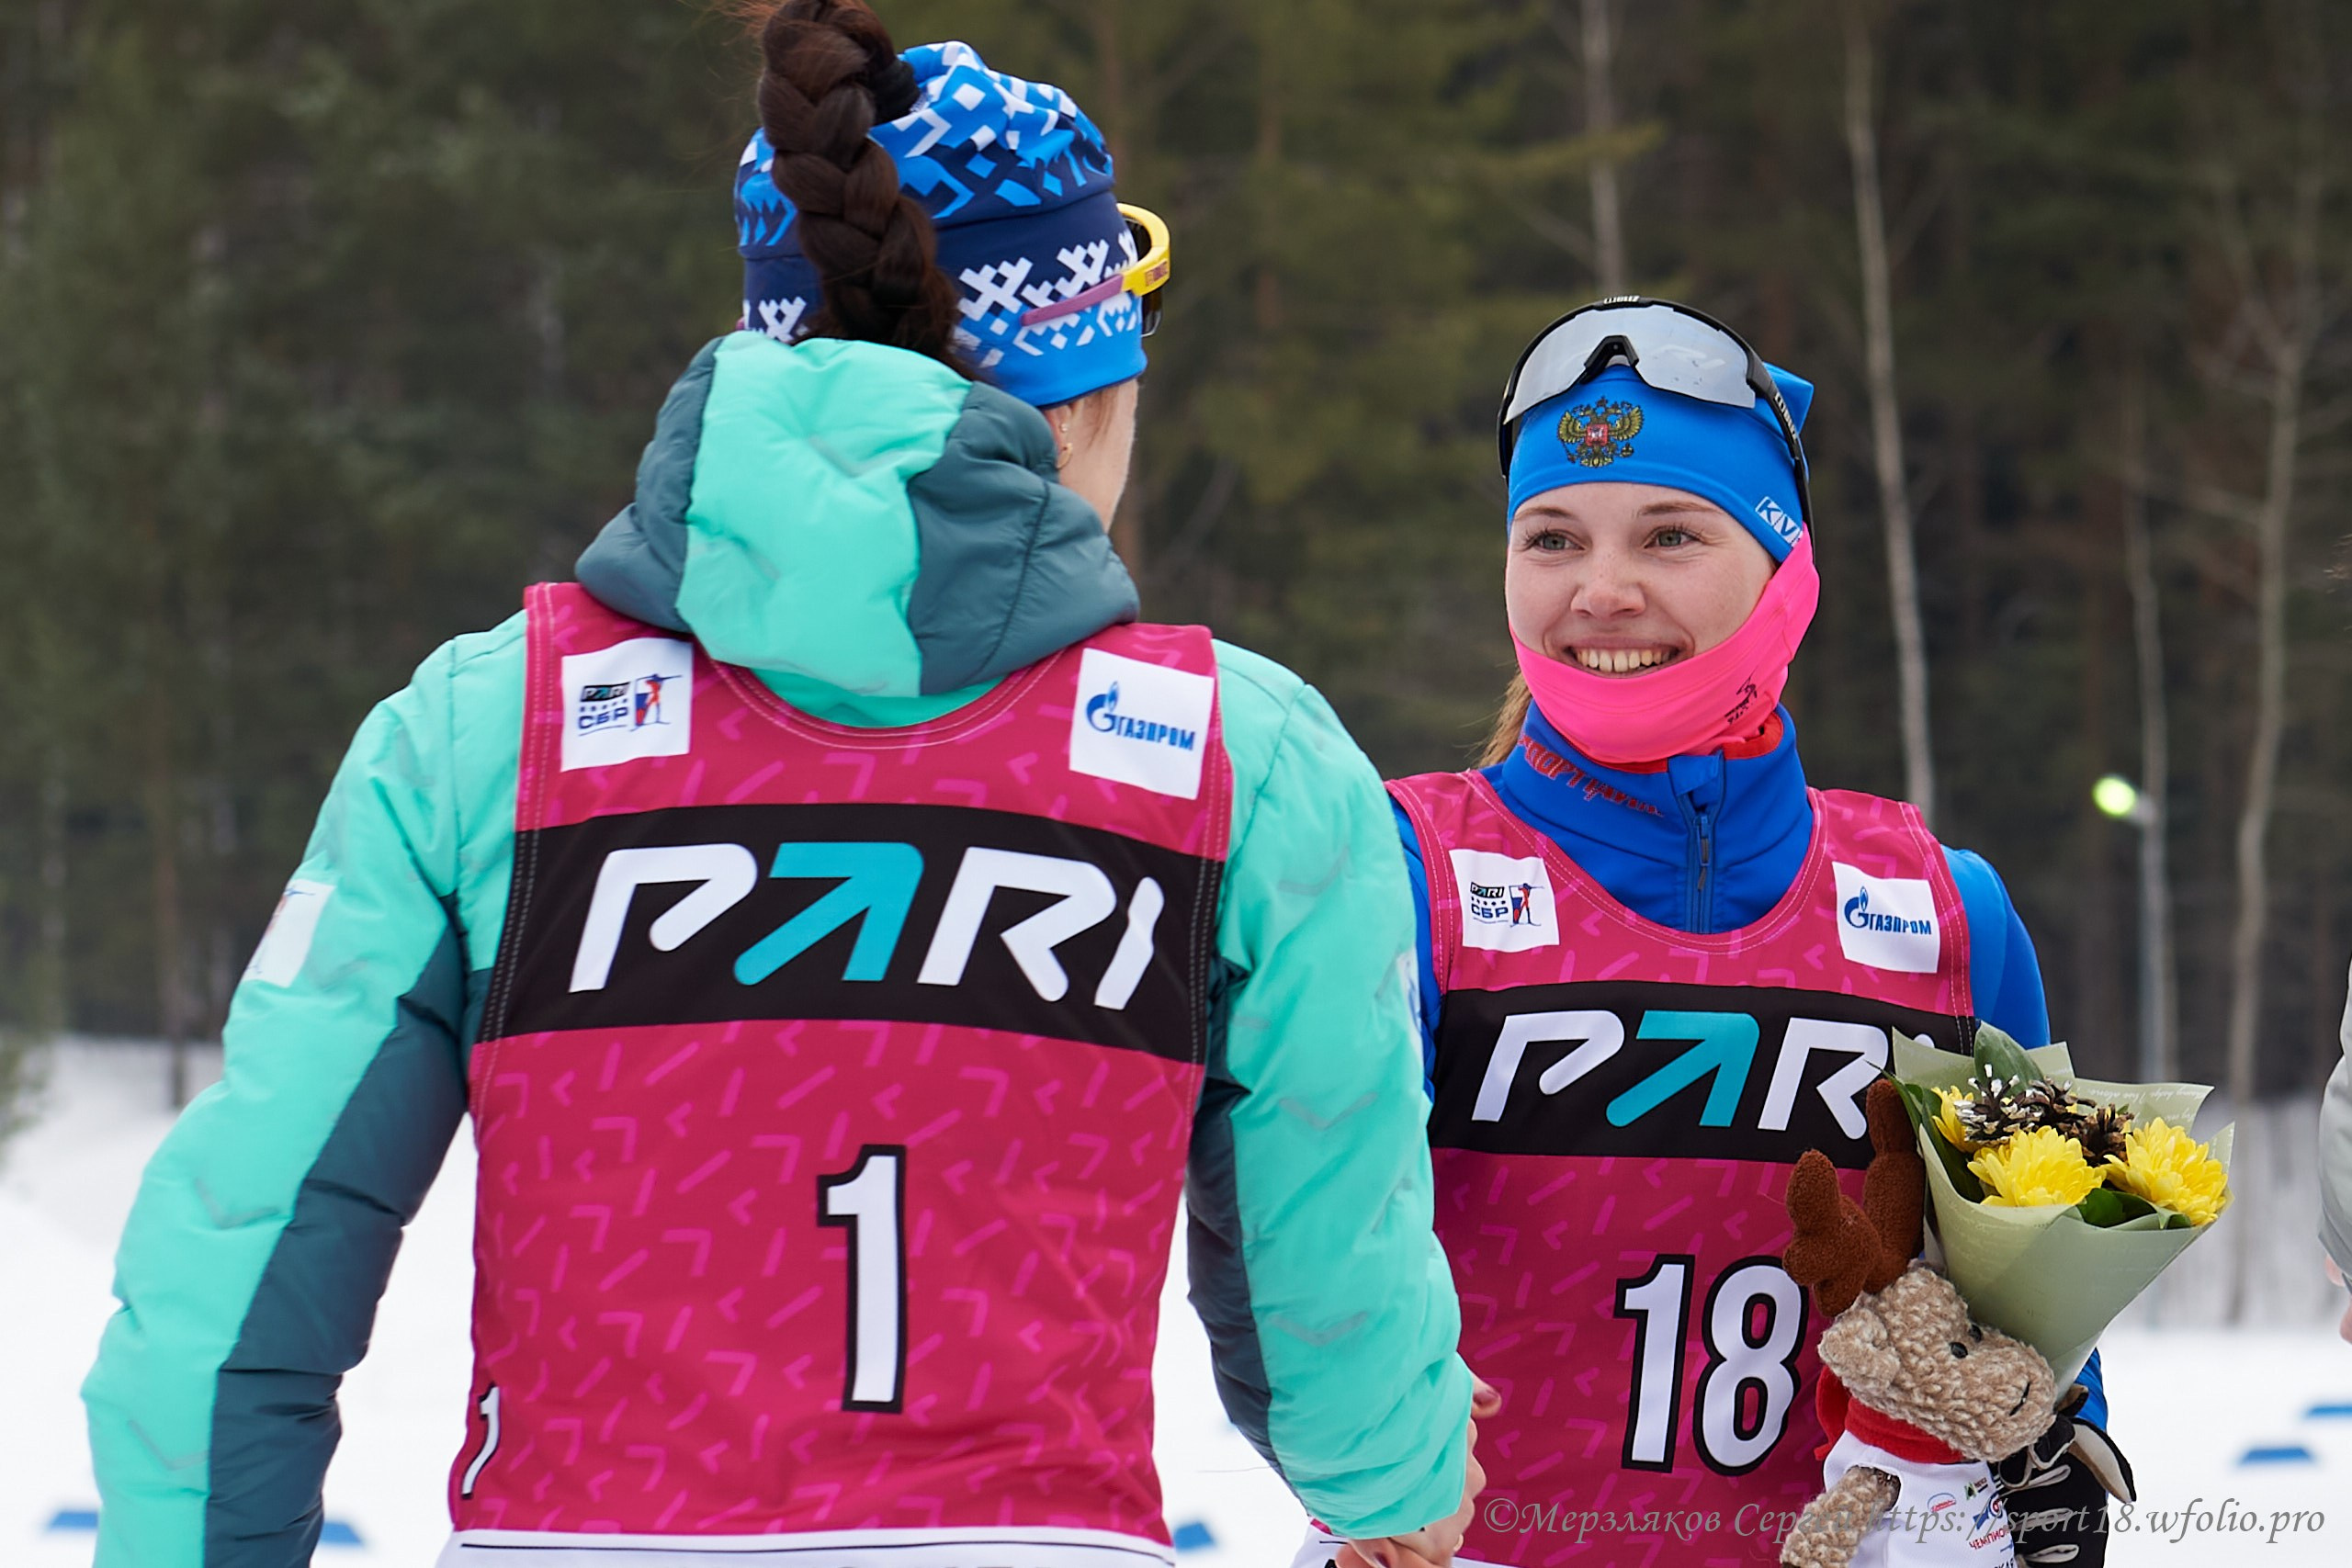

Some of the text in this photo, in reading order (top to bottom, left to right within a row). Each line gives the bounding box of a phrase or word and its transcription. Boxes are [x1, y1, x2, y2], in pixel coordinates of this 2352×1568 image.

[1756, 497, 1803, 547] KV
[1117, 716, 1195, 750] ГАЗПРОМ
[569, 842, 1163, 1010] PARI
[1471, 883, 1504, 898] PARI
[1471, 903, 1509, 919] СБР
[1869, 913, 1932, 935] ГАЗПРОМ
[1472, 1010, 1935, 1140] PAR
[819, 1145, 906, 1412] 1
[1614, 1254, 1808, 1475] 18
[462, 1382, 500, 1499] 1
